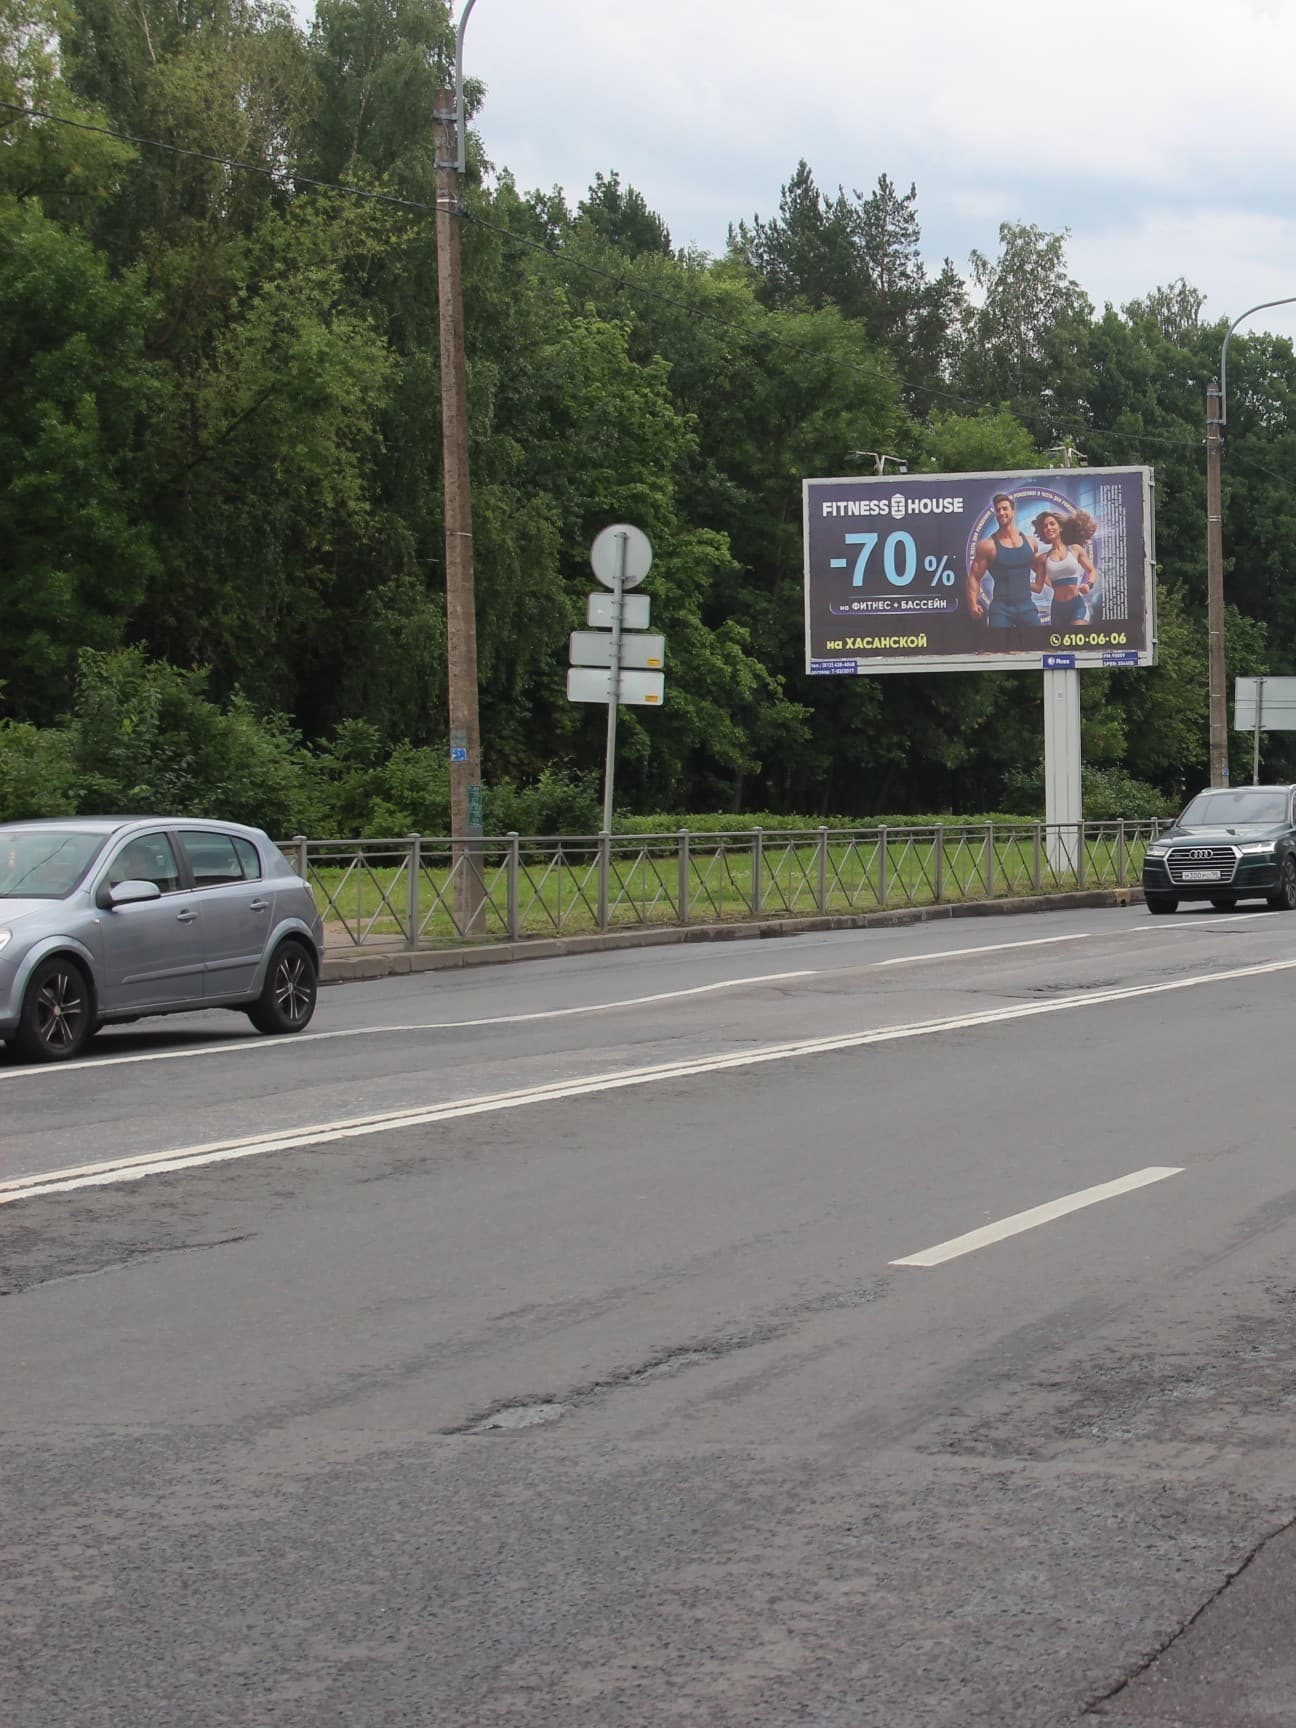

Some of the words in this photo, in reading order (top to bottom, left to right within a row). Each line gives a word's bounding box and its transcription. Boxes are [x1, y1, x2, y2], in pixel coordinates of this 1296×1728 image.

[822, 500, 889, 517] FITNESS
[908, 497, 964, 515] HOUSE
[852, 600, 892, 611] ФИТНЕС
[901, 598, 947, 610] БАССЕЙН
[826, 639, 843, 650] на
[845, 633, 927, 649] ХАСАНСКОЙ
